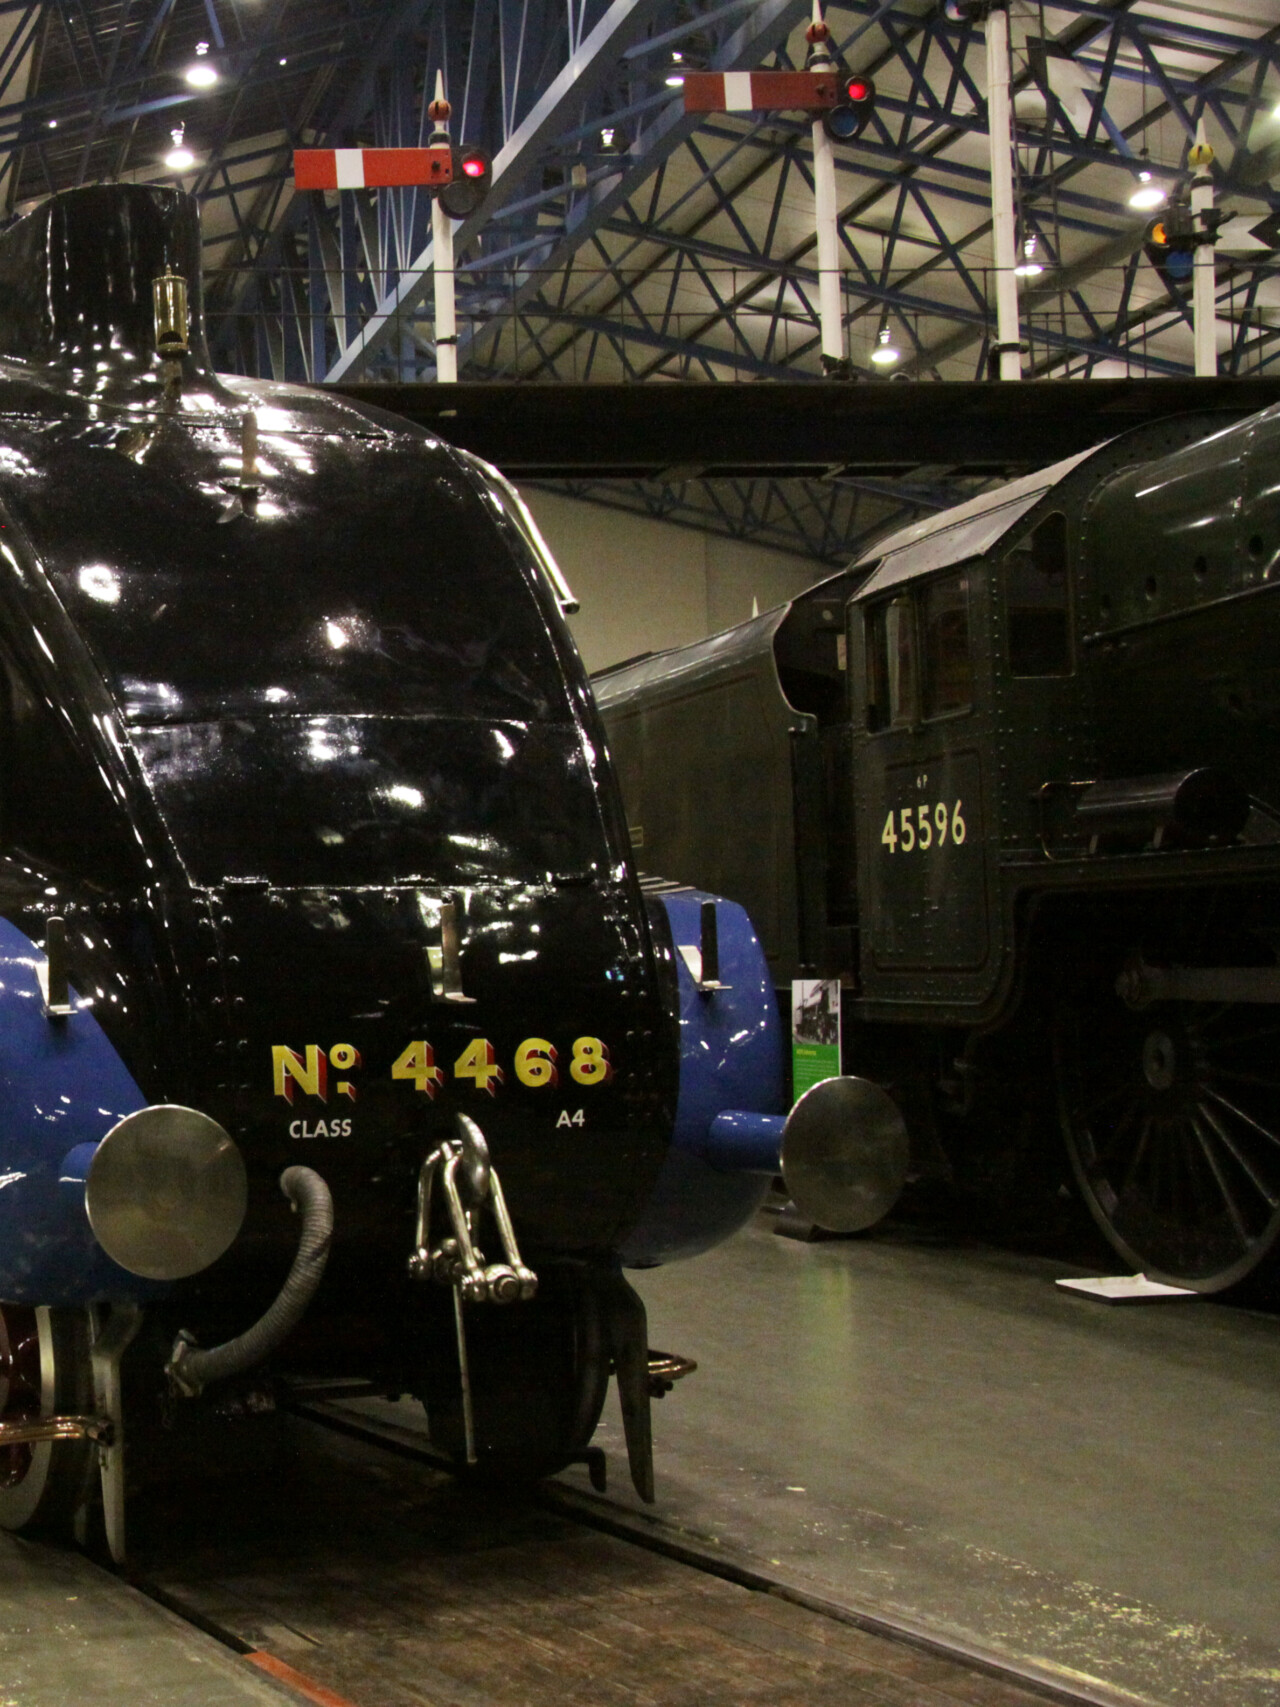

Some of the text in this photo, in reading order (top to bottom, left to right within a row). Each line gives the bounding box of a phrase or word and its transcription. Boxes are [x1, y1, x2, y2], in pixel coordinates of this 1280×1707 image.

[881, 799, 966, 854] 45596
[391, 1036, 610, 1099] 4468
[288, 1109, 585, 1139] CLASS A4
